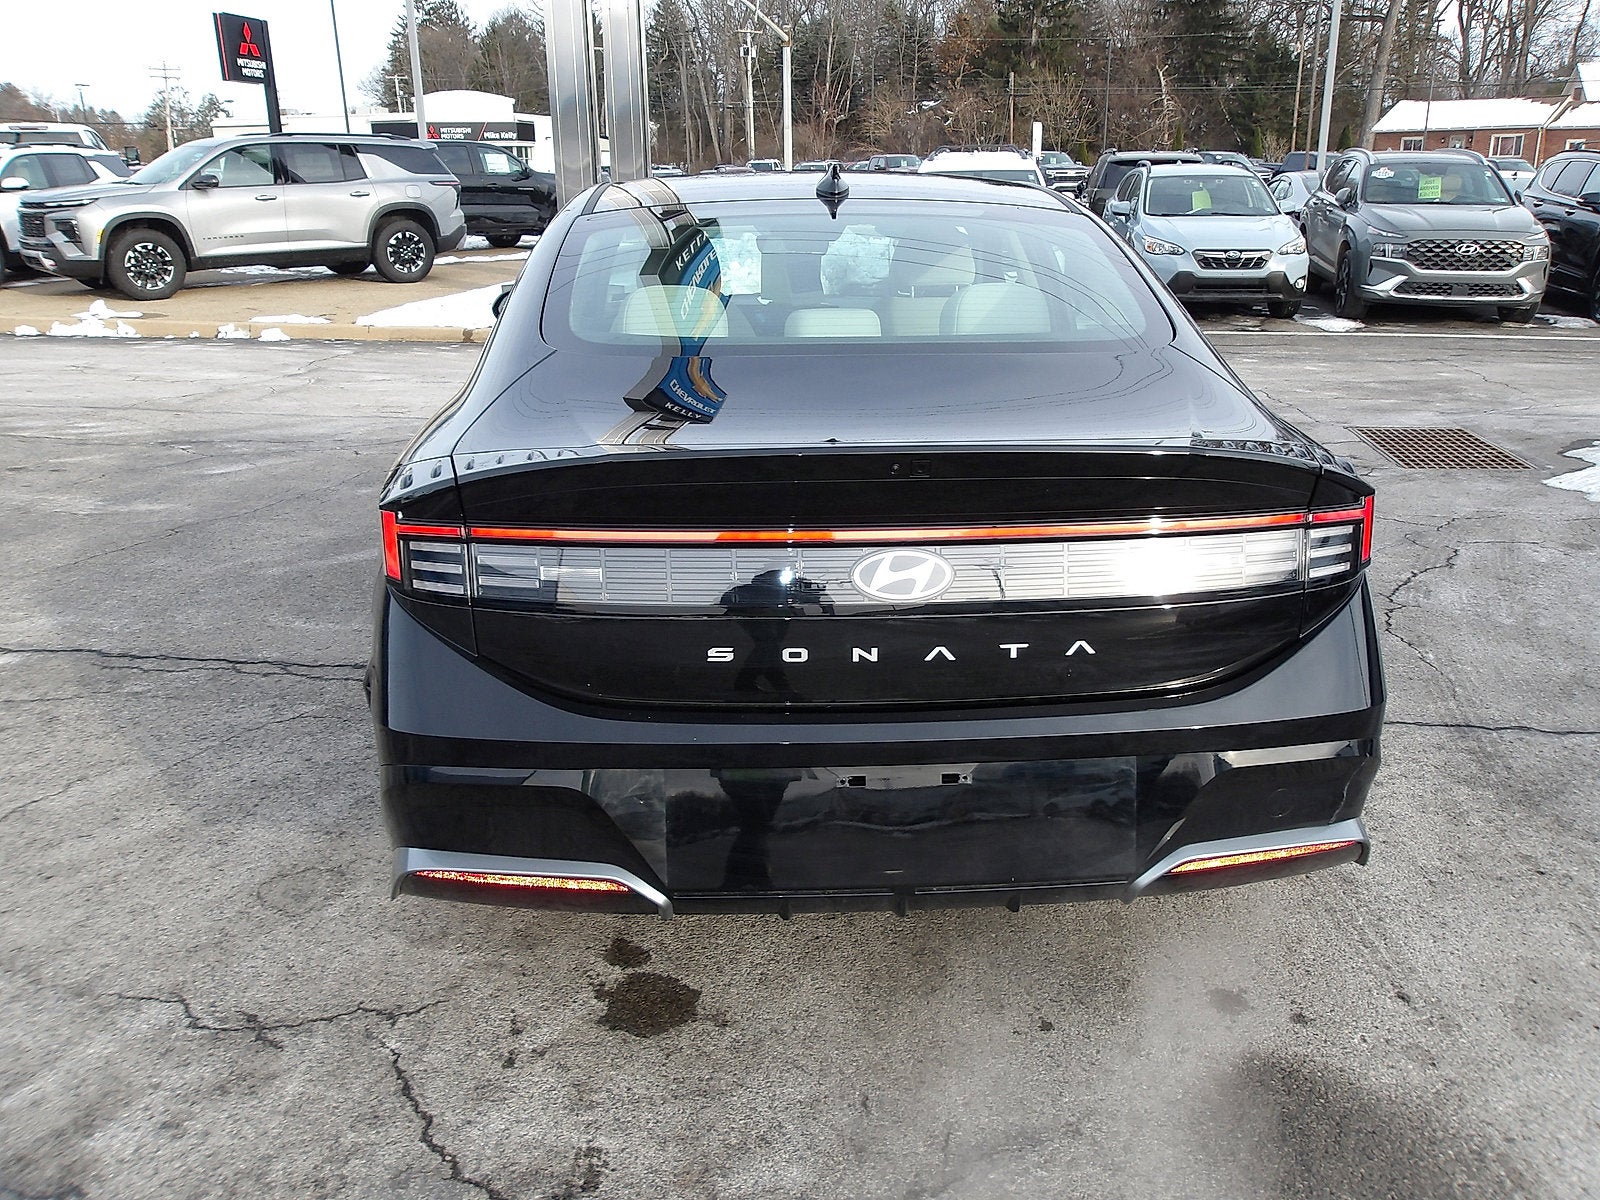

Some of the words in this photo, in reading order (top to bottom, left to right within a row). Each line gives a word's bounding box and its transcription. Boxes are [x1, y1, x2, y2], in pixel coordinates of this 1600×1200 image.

[236, 57, 267, 70] MITSUBISHI
[241, 67, 265, 79] MOTORS
[483, 131, 500, 140] Mike
[500, 131, 518, 140] Kelly
[670, 379, 717, 414] CHEVROLET
[665, 401, 702, 419] KELLY
[706, 640, 1097, 663] SONATA
